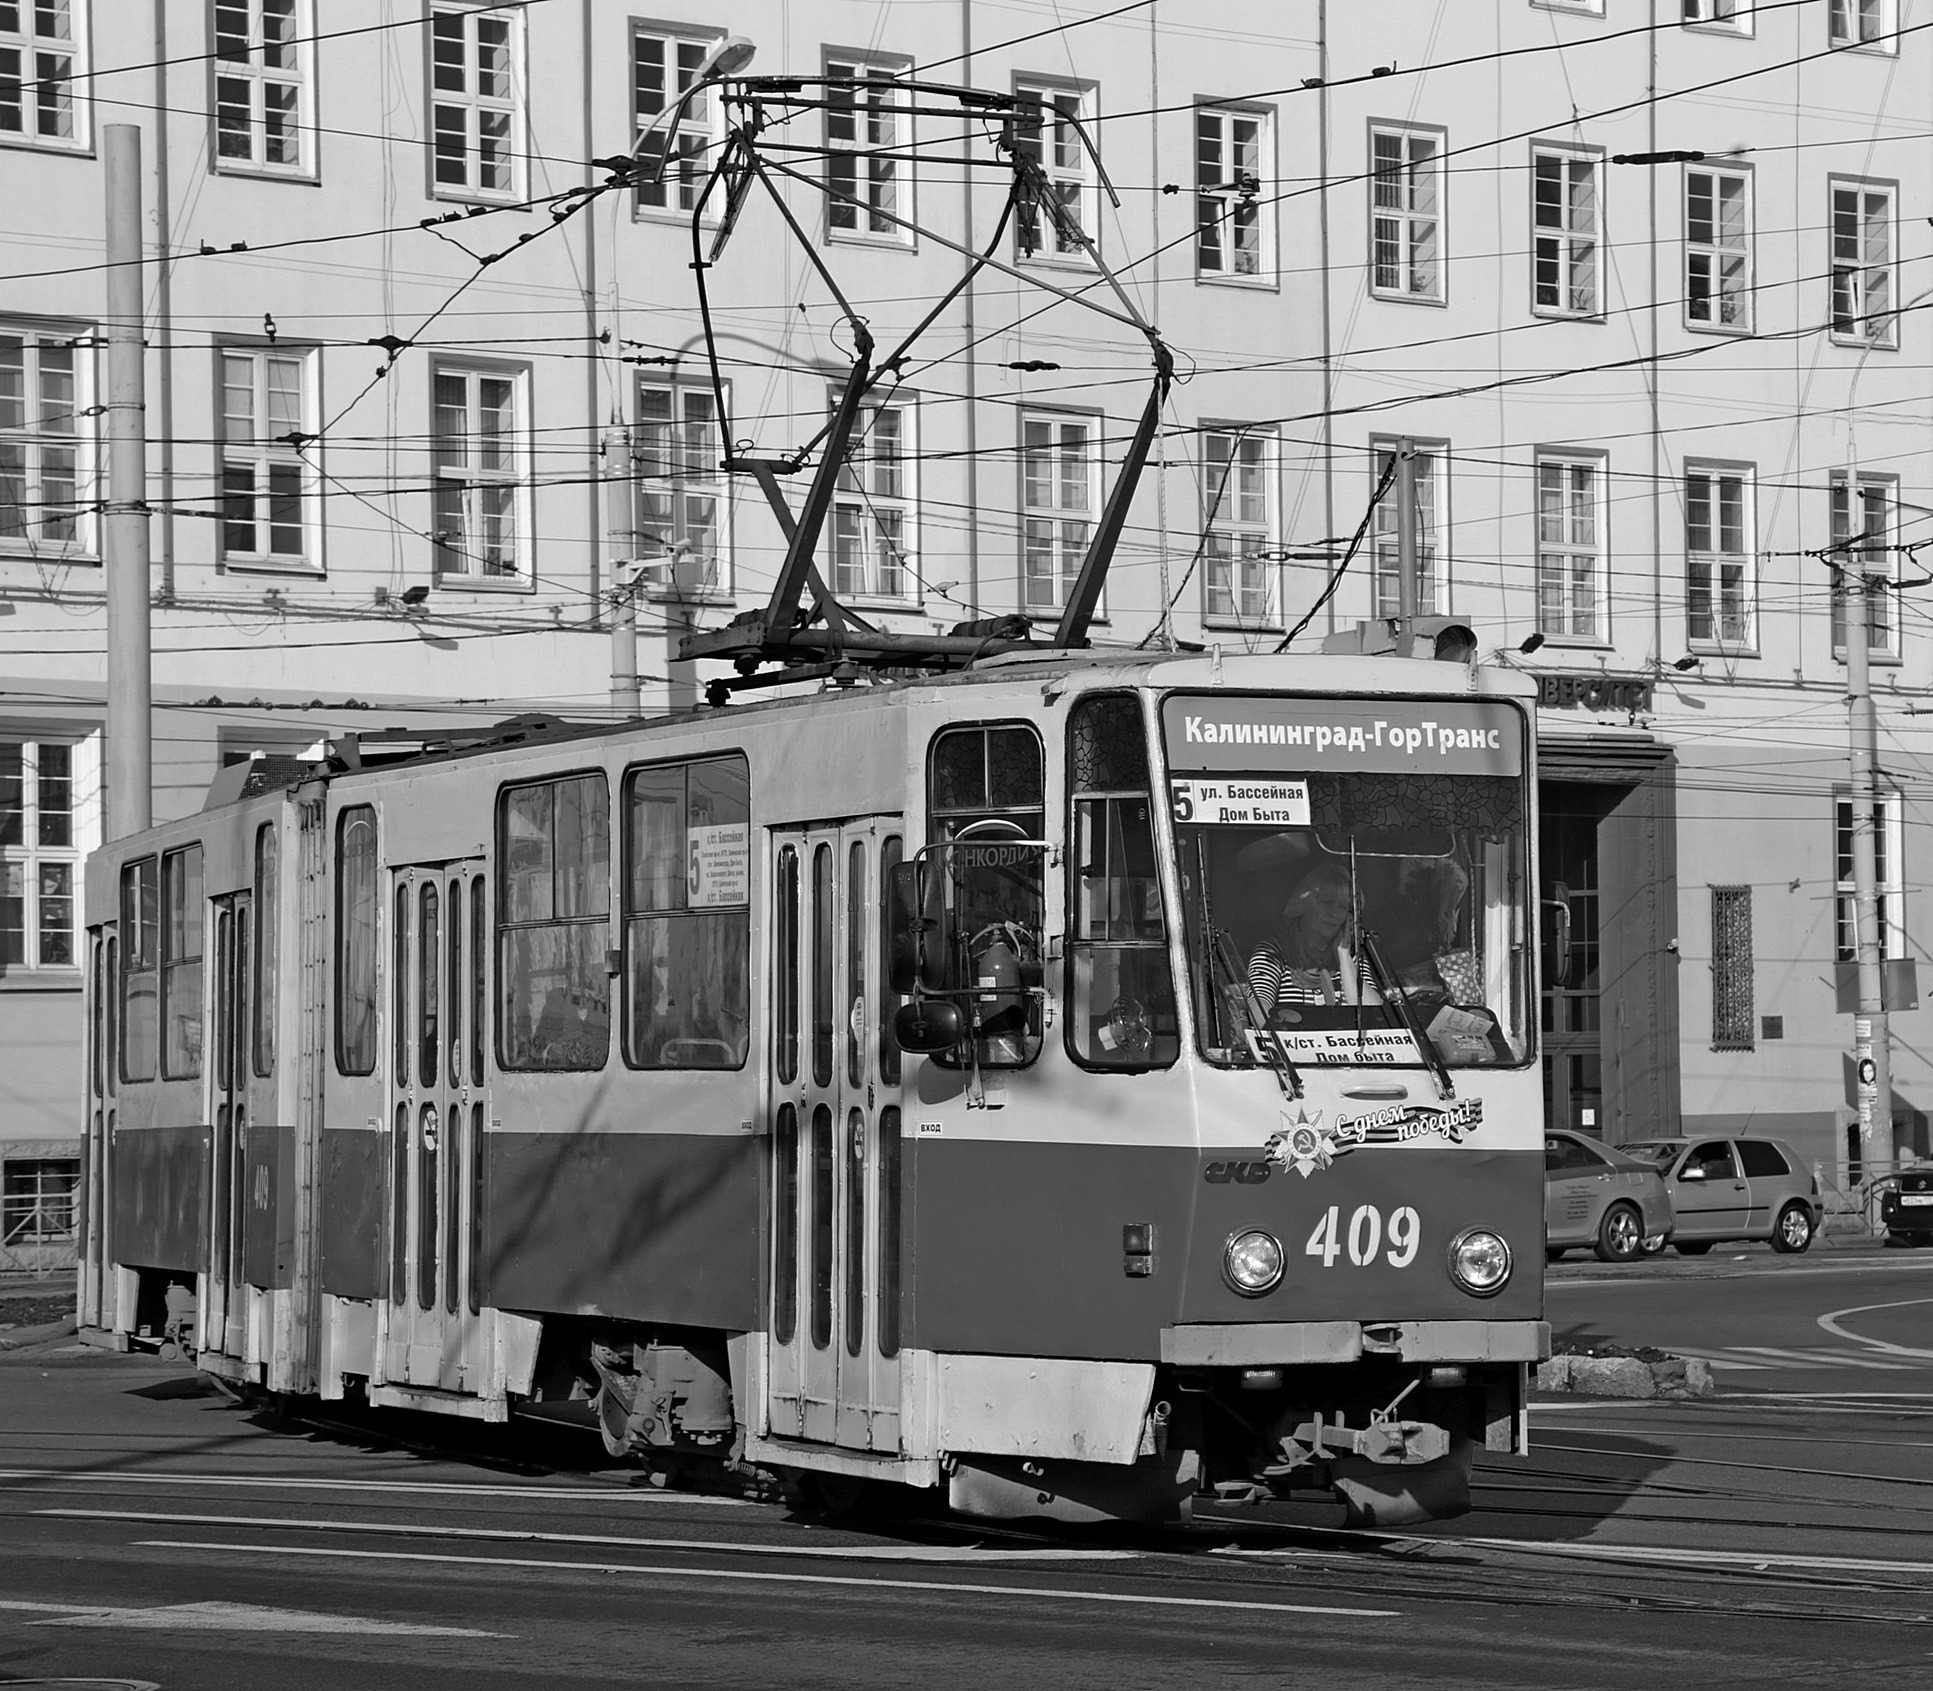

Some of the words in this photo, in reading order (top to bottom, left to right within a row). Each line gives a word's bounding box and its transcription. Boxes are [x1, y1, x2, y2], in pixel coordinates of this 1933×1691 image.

[1185, 716, 1500, 754] Калининград-ГорТранс
[1173, 786, 1193, 821] 5
[1200, 786, 1222, 801] ул.
[1227, 782, 1304, 801] Бассейная
[1219, 807, 1249, 824] Дом
[1253, 807, 1290, 822] Быта
[689, 840, 700, 895] 5
[1326, 1034, 1413, 1047] Бассейная
[1336, 1113, 1352, 1138] С
[1397, 1098, 1471, 1142] победы!
[1305, 1204, 1421, 1268] 409
